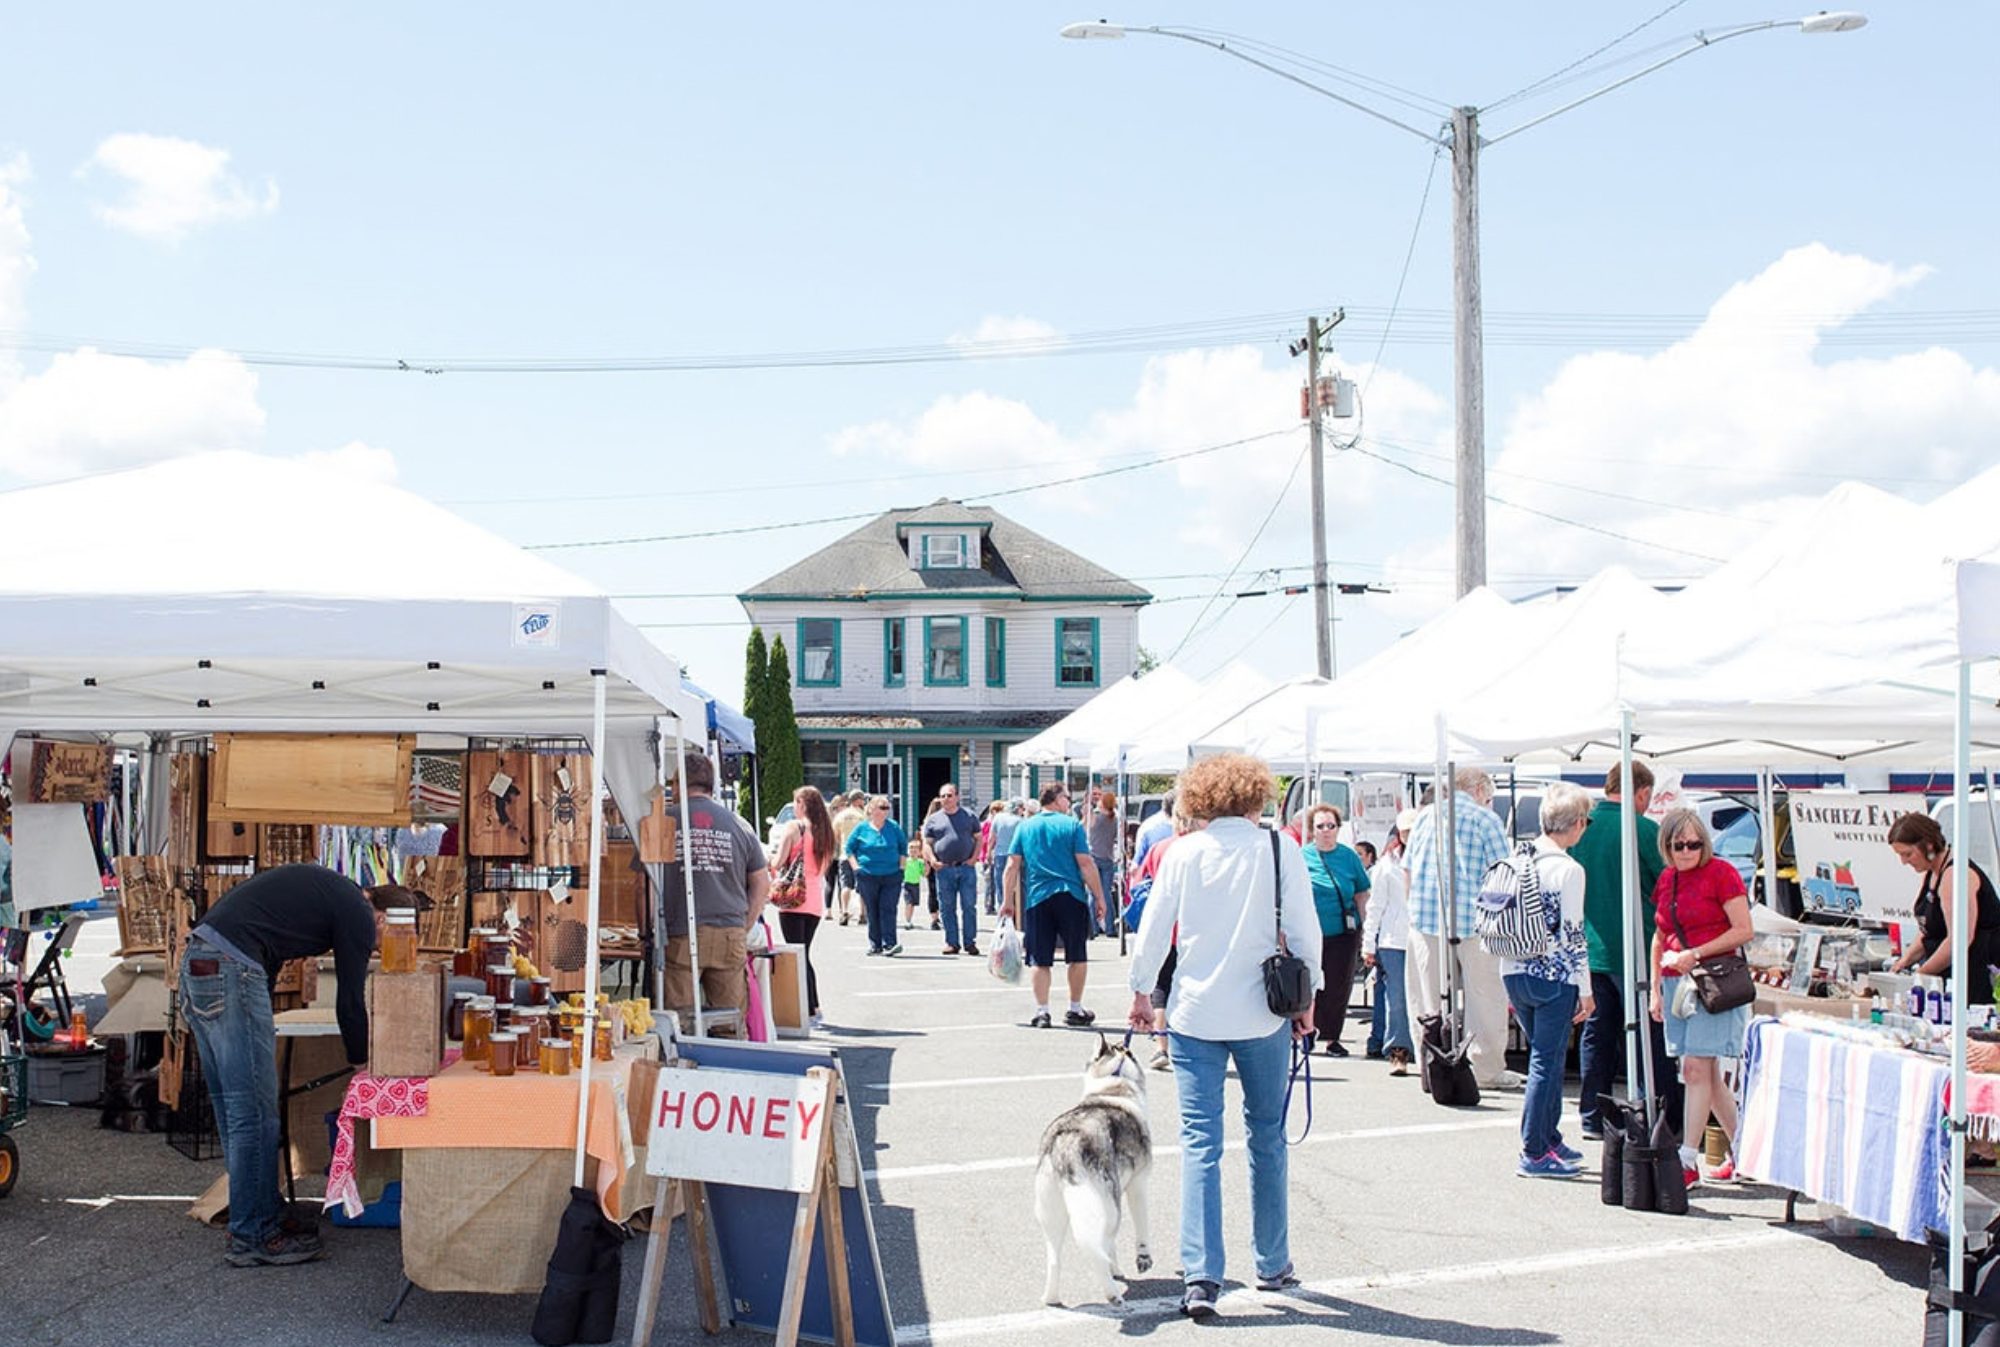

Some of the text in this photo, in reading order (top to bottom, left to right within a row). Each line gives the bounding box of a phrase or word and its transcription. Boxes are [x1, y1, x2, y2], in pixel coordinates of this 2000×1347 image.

[1795, 802, 1863, 825] SANCHEZ
[1834, 831, 1887, 842] MOUNT VER
[658, 1090, 820, 1140] HONEY
